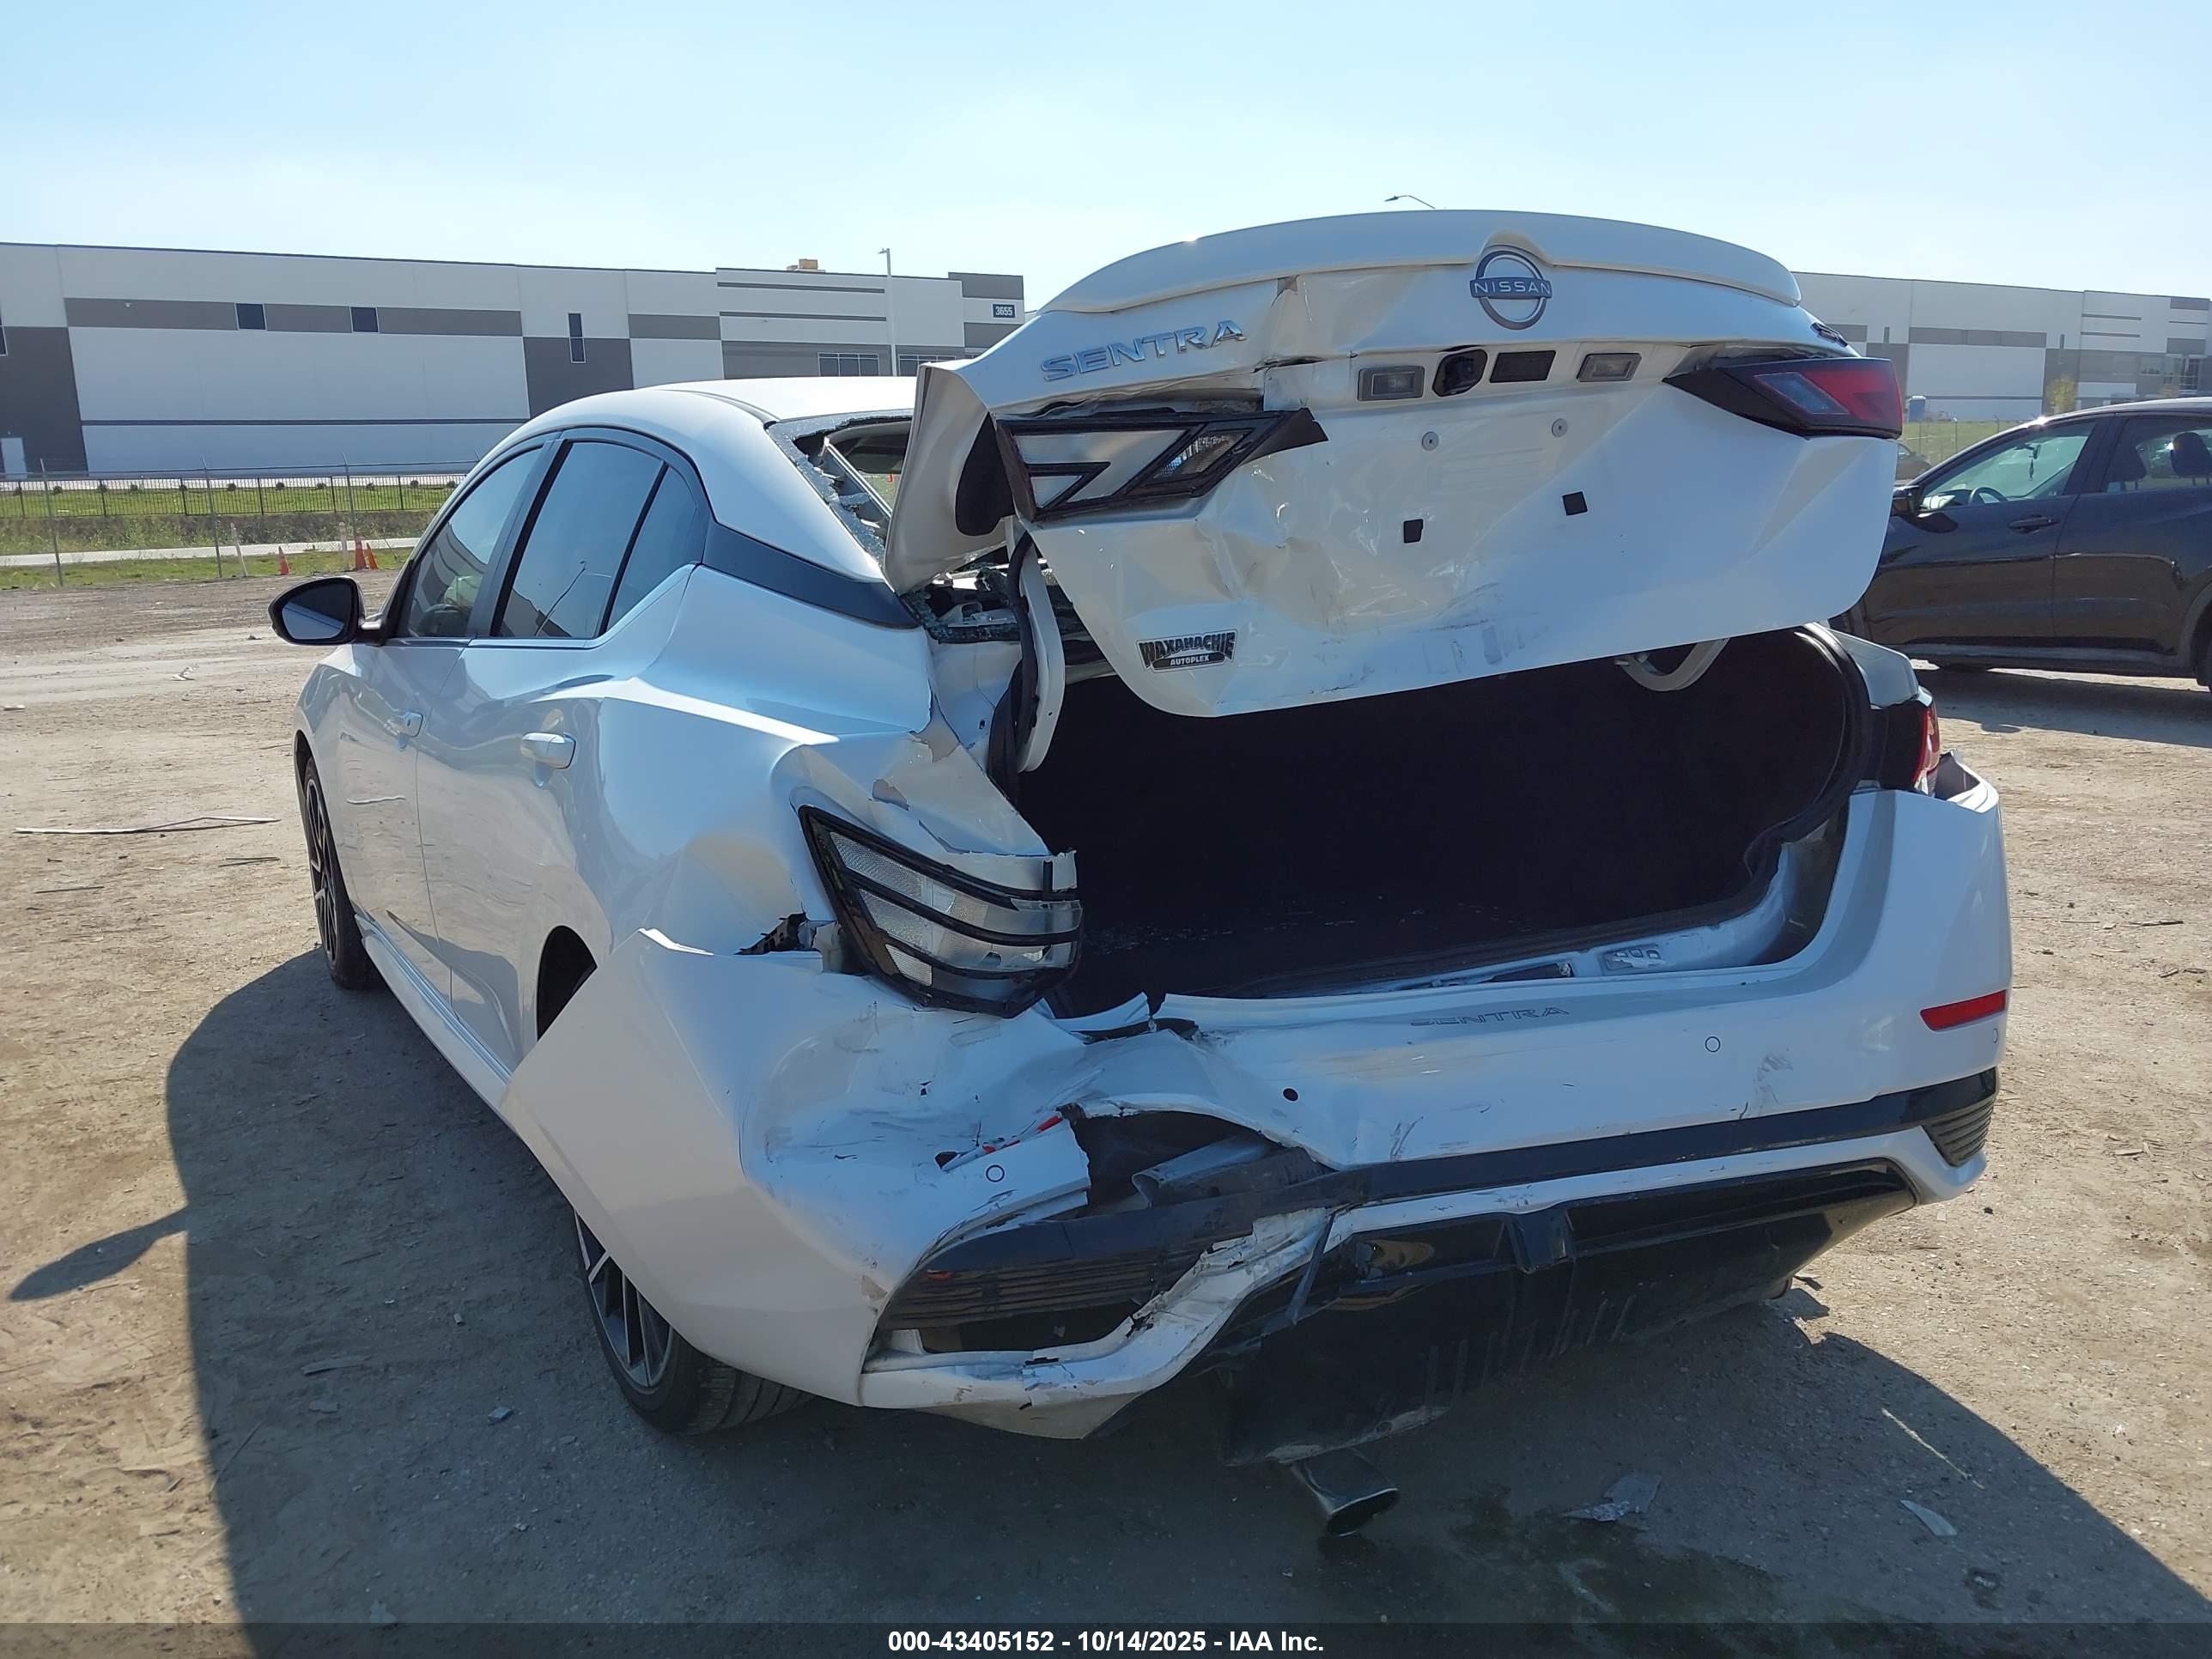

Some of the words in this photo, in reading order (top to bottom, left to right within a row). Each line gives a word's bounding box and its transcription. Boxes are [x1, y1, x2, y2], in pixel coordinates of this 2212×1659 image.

[1474, 281, 1550, 294] NISSAN
[996, 306, 1013, 315] 3655
[1042, 319, 1247, 381] SENTRA
[1170, 654, 1209, 665] AUTOPLEX
[1410, 1006, 1569, 1026] SENTRA
